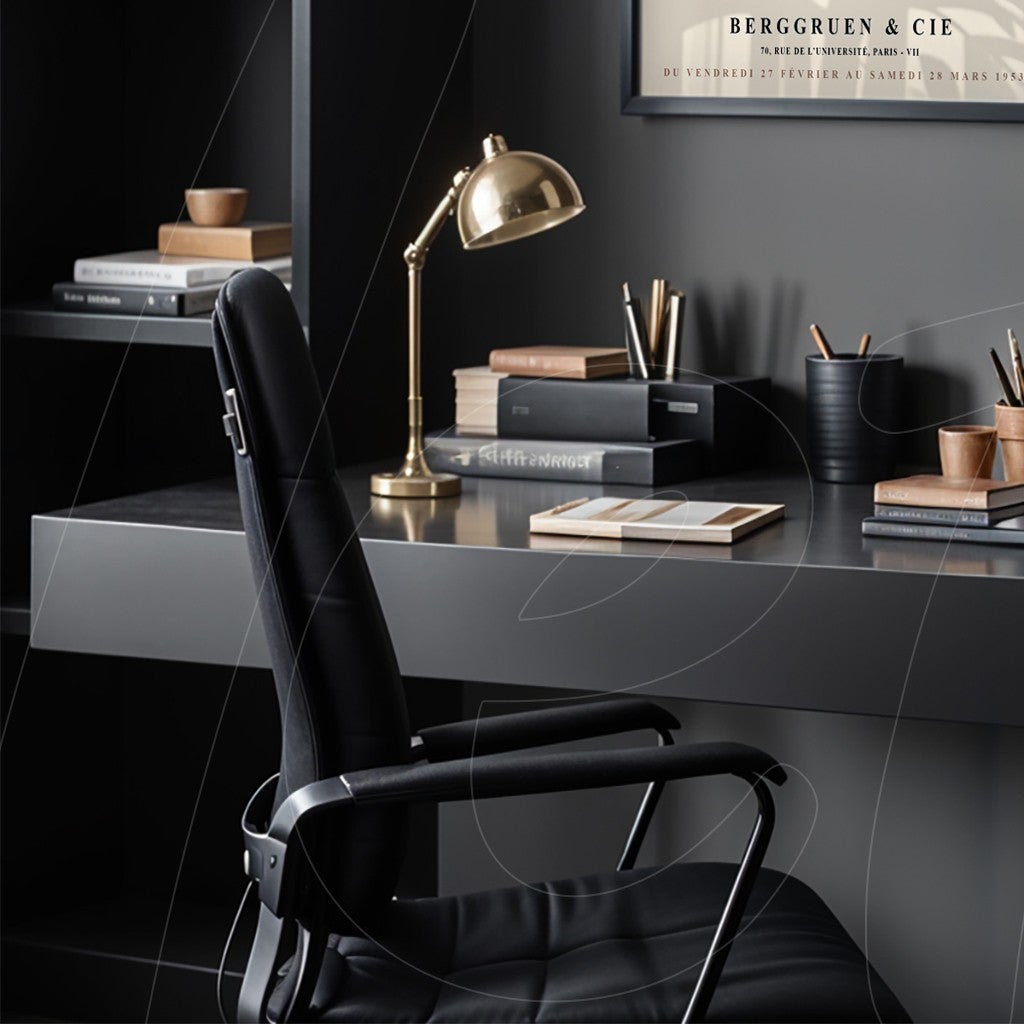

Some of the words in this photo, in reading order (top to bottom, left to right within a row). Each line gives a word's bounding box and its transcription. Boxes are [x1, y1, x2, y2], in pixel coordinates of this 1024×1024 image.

[729, 16, 873, 36] BERGGRUEN
[885, 17, 900, 36] &
[912, 17, 953, 36] CIE
[760, 46, 773, 57] 70,
[774, 46, 792, 56] RUE
[794, 46, 806, 56] DE
[872, 47, 899, 57] PARIS
[906, 47, 920, 57] VII
[663, 67, 680, 78] DU
[686, 67, 754, 79] VENDREDI
[760, 68, 774, 79] 27
[780, 65, 840, 80] FÉVRIER
[845, 70, 863, 80] AU
[869, 70, 923, 81] SAMEDI
[928, 71, 943, 81] 28
[950, 71, 989, 82] MARS
[995, 72, 1024, 83] 1953
